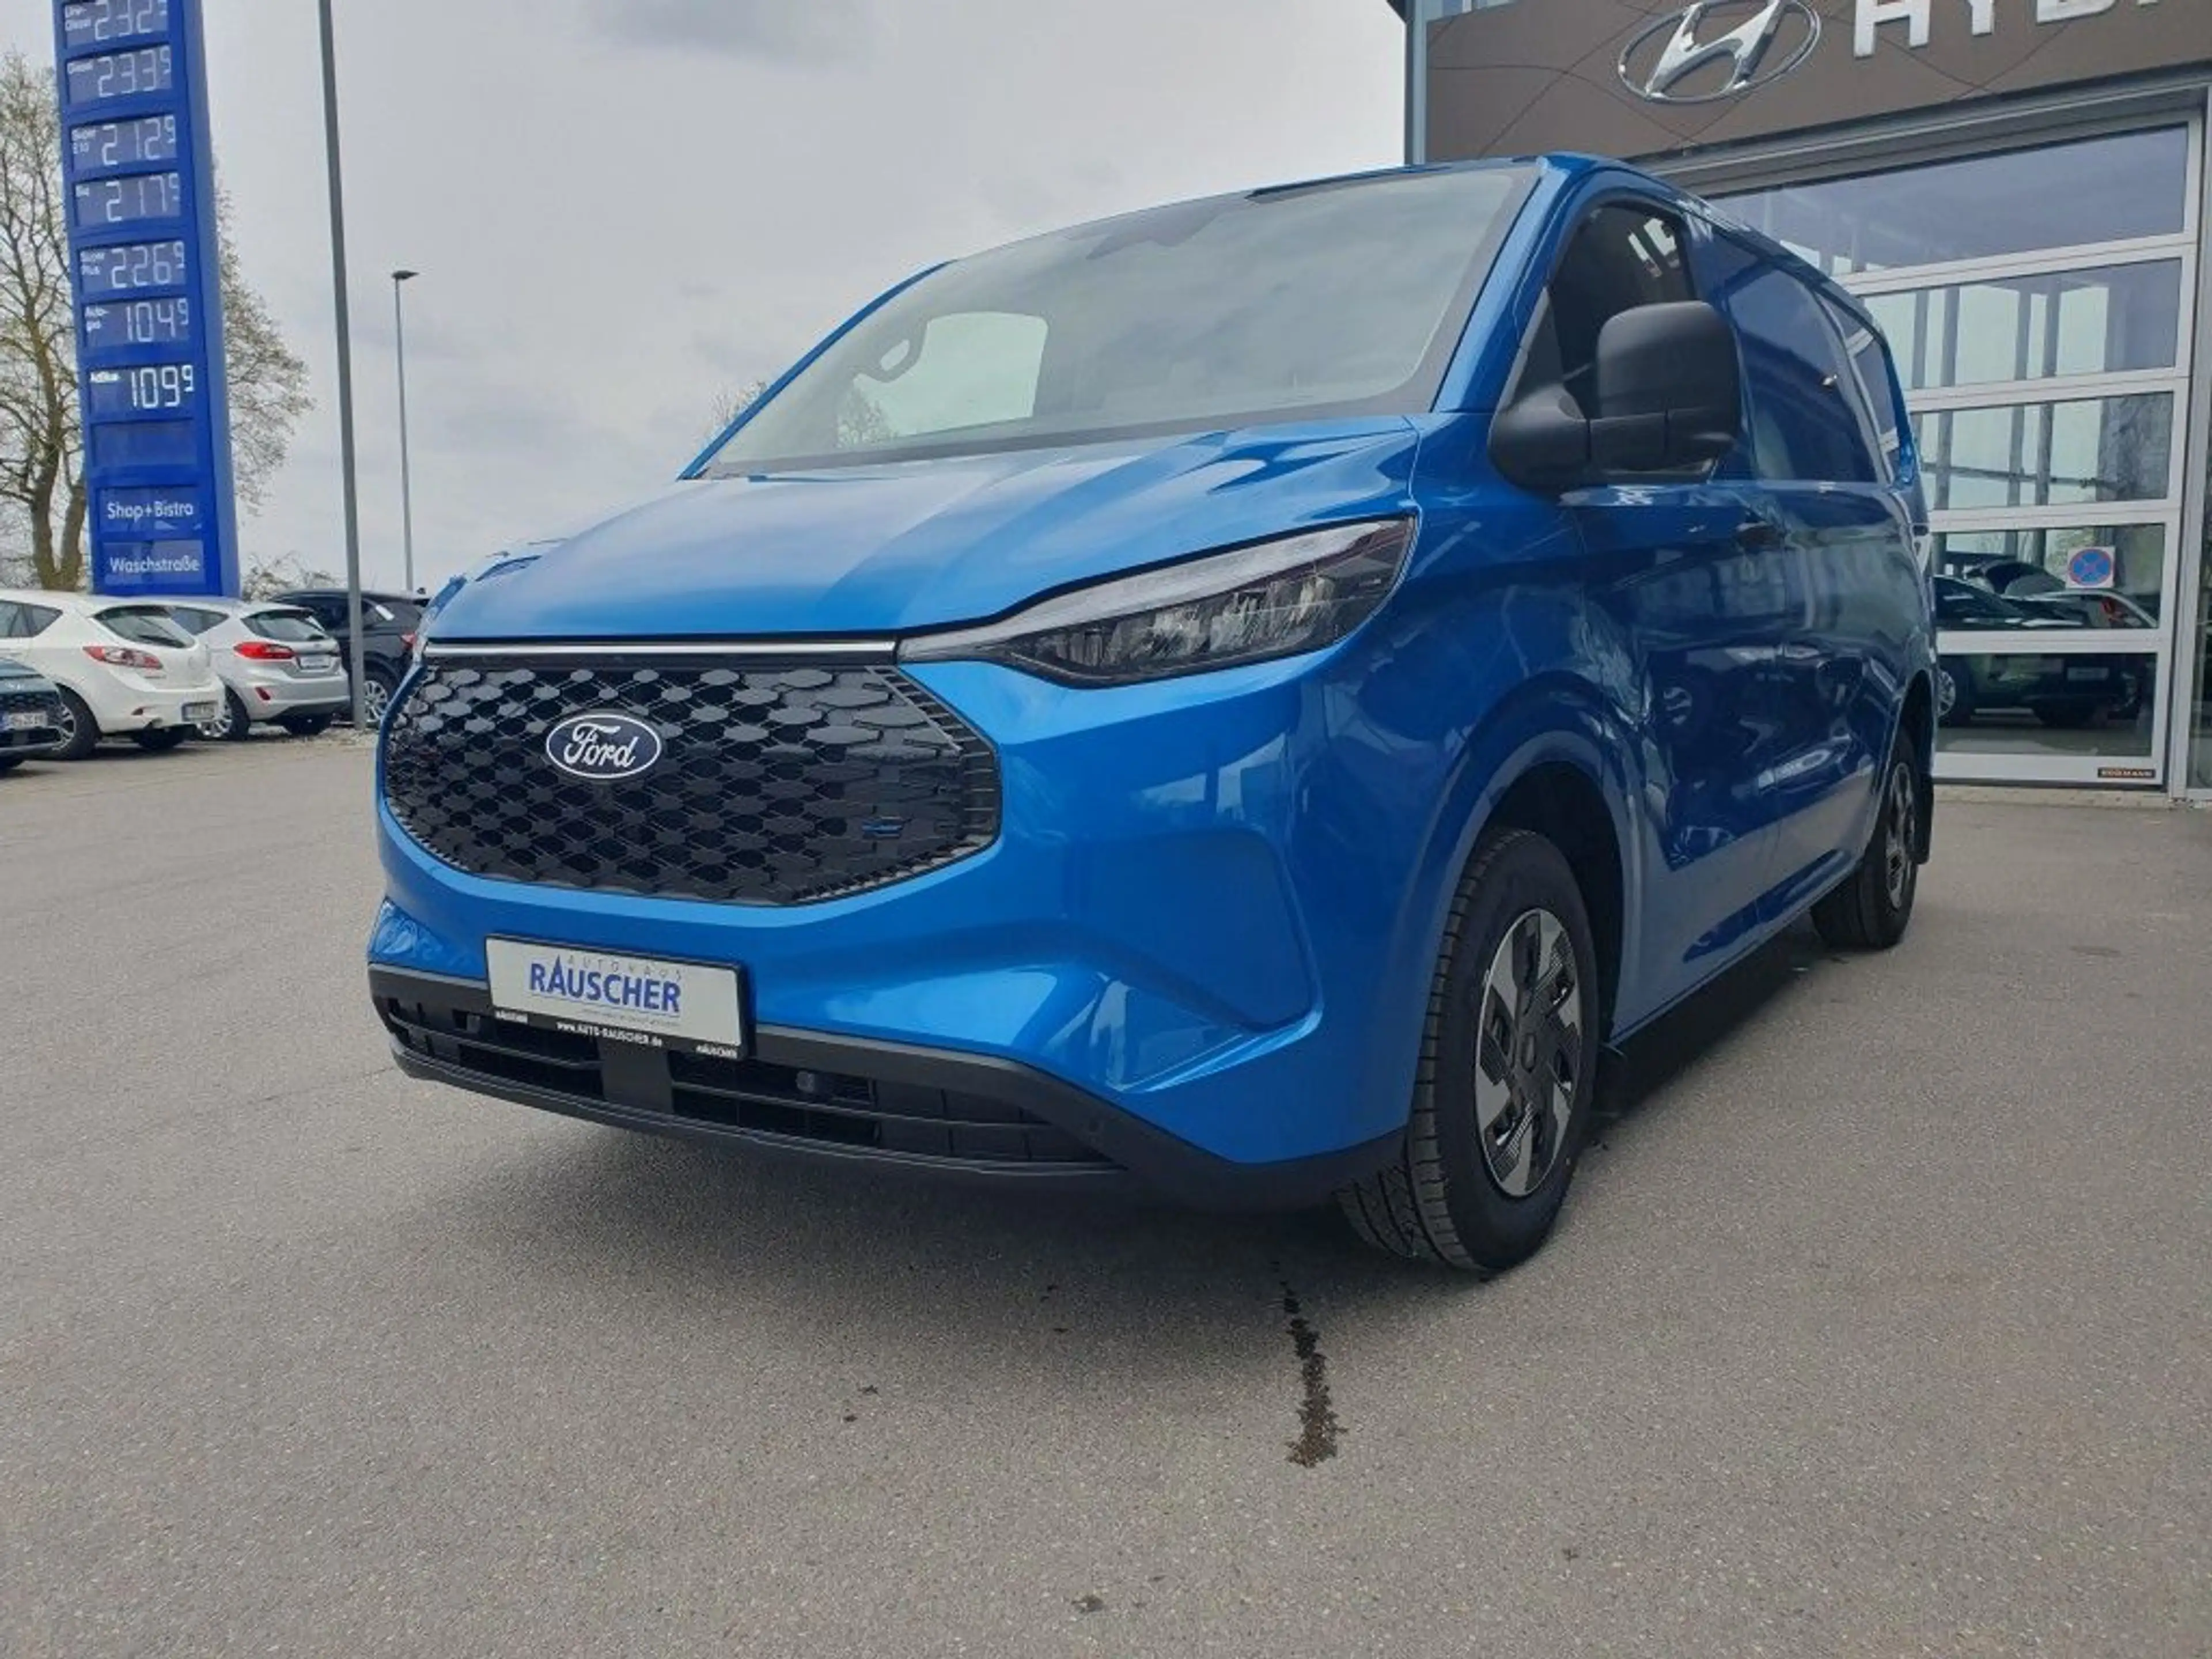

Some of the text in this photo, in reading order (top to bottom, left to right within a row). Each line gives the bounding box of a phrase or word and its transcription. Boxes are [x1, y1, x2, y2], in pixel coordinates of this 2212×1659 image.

[101, 115, 176, 165] 2129
[111, 240, 184, 288] 2269
[126, 297, 189, 342] 1049
[131, 365, 194, 409] 1099
[563, 722, 639, 767] Ford
